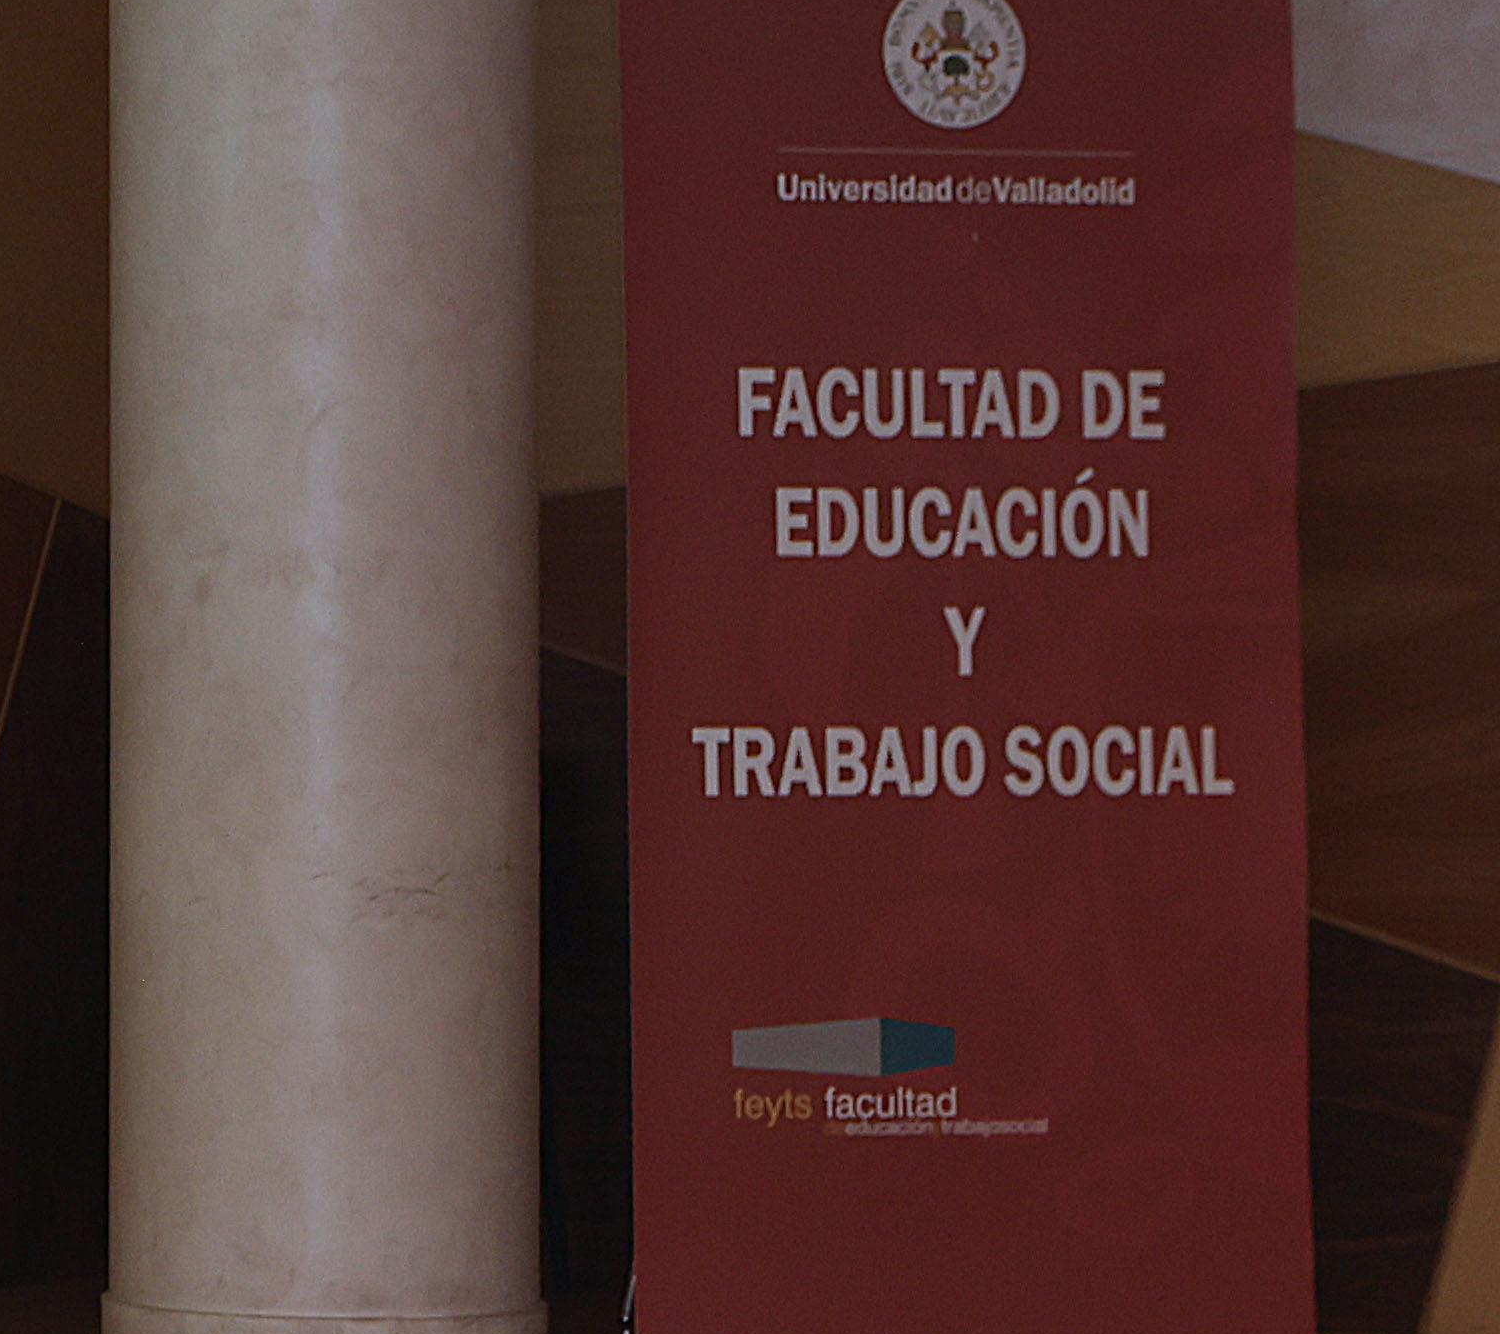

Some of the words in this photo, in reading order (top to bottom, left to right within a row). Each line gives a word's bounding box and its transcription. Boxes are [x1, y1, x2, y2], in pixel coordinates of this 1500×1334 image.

[776, 173, 954, 206] Universidad
[956, 178, 991, 205] de
[991, 176, 1137, 206] Valladolid
[737, 367, 1061, 440] FACULTAD
[1081, 370, 1168, 440] DE
[774, 468, 1151, 559] EDUCACIÓN
[942, 605, 987, 677] Y
[690, 725, 987, 798] TRABAJO
[1002, 725, 1236, 798] SOCIAL
[733, 1087, 813, 1128] feyts
[824, 1085, 958, 1121] facultad
